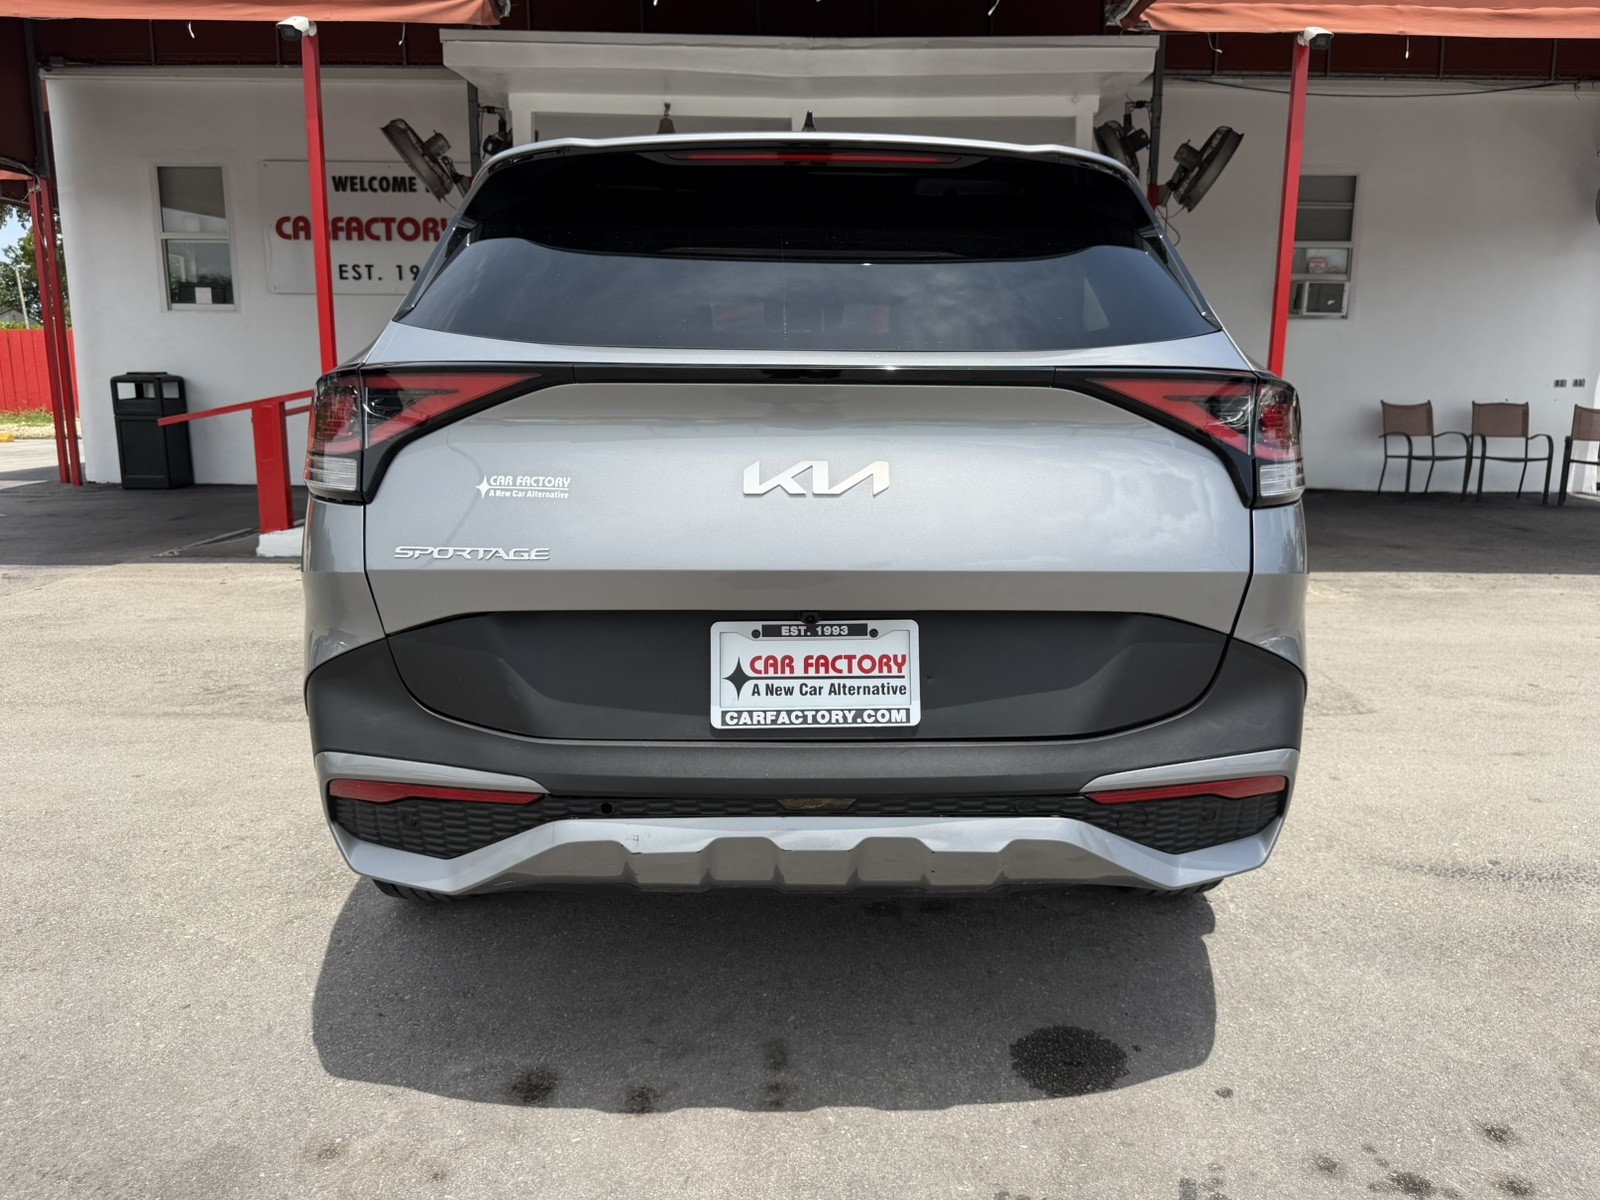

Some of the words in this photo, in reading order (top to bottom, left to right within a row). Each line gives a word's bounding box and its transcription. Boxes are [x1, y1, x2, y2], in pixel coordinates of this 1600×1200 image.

[331, 175, 418, 193] WELCOME
[275, 215, 313, 241] CA
[338, 264, 383, 281] EST.
[395, 264, 420, 281] 19
[489, 475, 513, 486] CAR
[516, 475, 571, 488] FACTORY
[743, 460, 890, 497] KIA
[488, 489, 495, 497] A
[495, 489, 511, 497] New
[512, 490, 526, 498] Car
[526, 490, 569, 499] Alternative
[394, 545, 550, 560] SPORTAGE
[780, 625, 811, 637] EST.
[815, 625, 849, 636] 1993
[749, 654, 795, 675] CAR
[803, 653, 907, 675] FACTORY
[751, 683, 761, 697] A
[765, 683, 795, 697] New
[799, 682, 824, 697] Car
[828, 681, 908, 697] Alternative
[724, 708, 908, 726] CARFACTORY.COM
